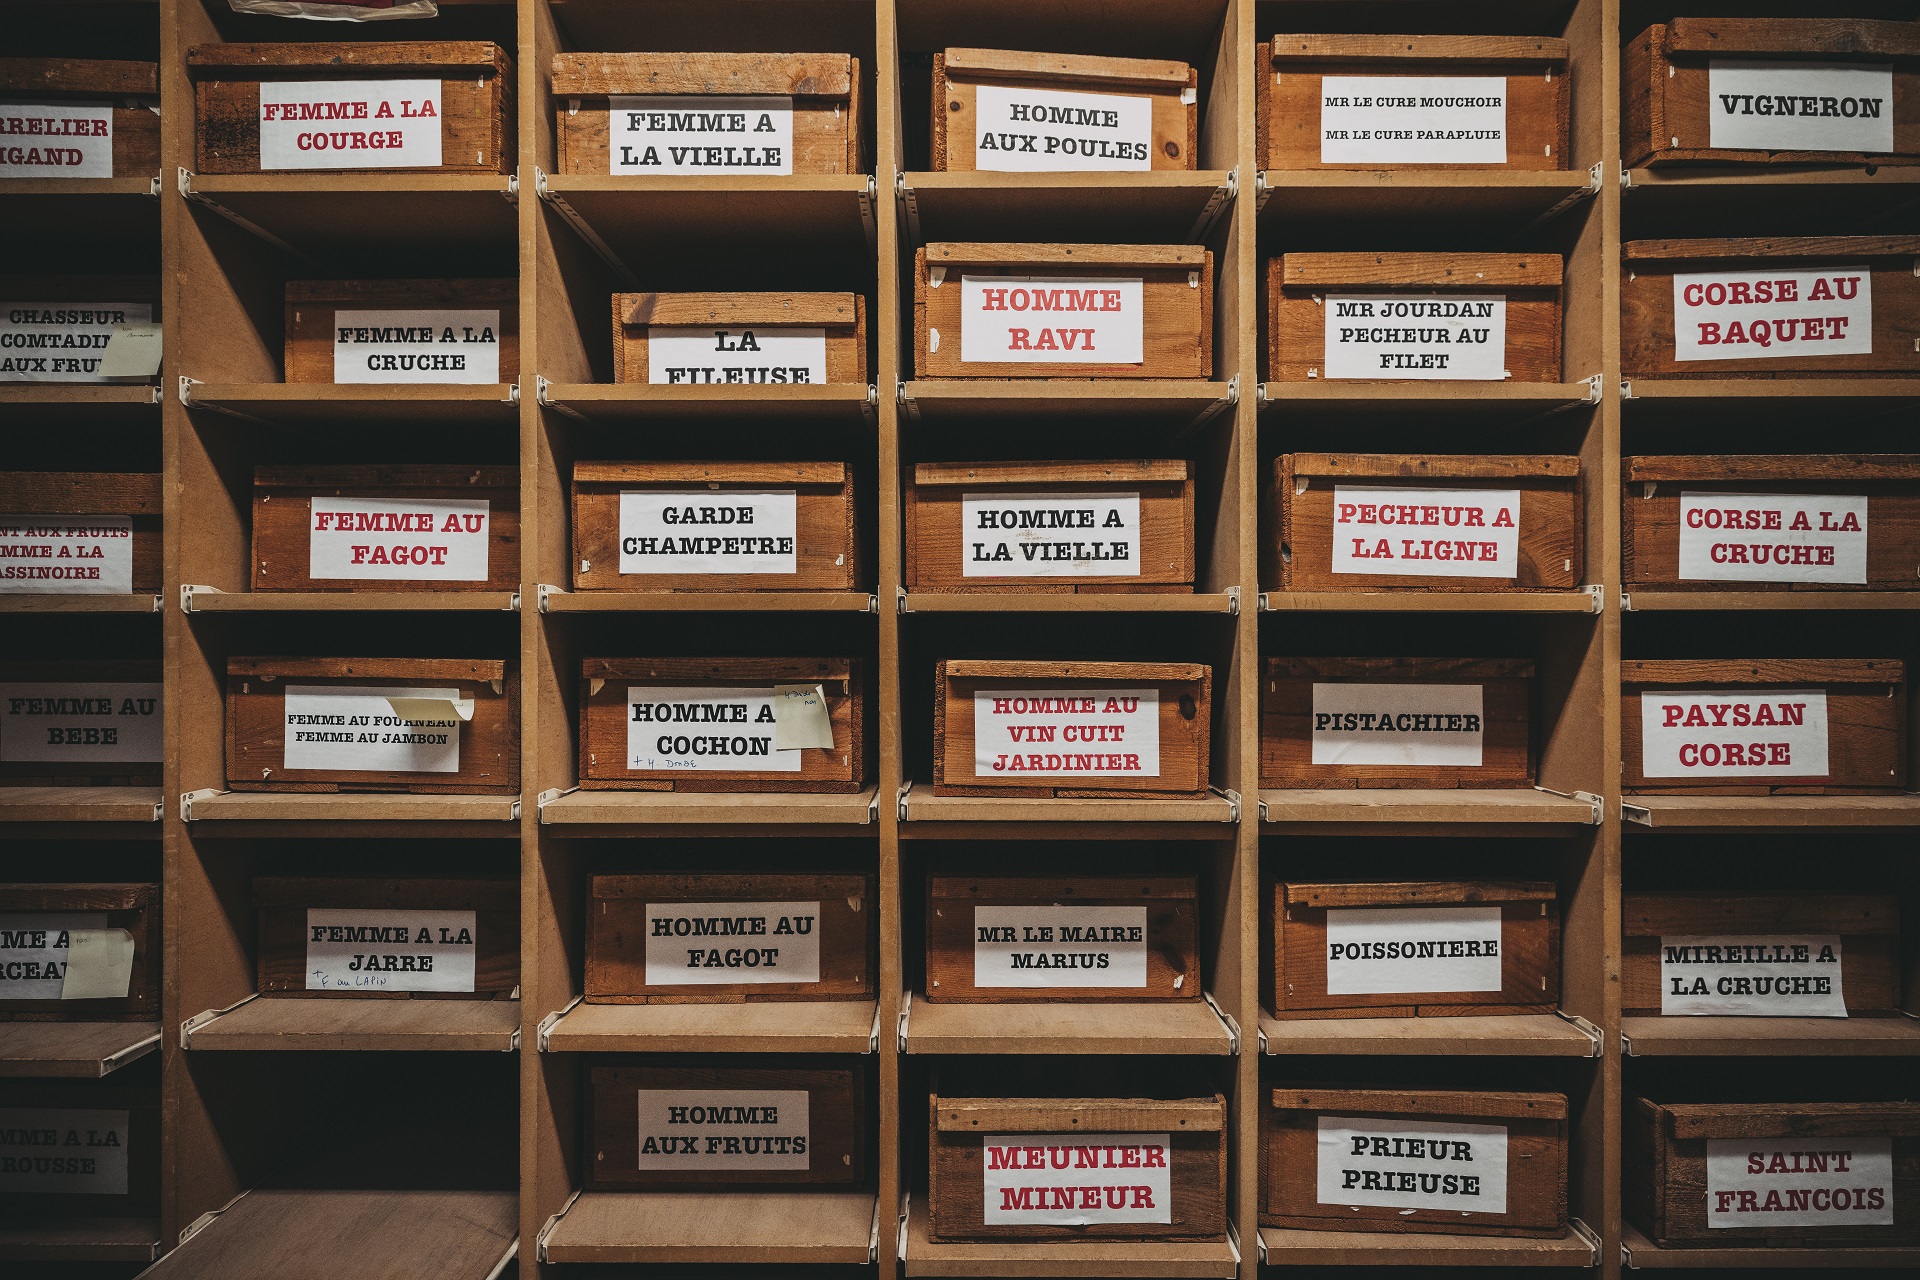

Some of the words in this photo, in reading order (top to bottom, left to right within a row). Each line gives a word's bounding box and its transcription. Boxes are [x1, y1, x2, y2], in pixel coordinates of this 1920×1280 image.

[263, 102, 368, 121] FEMME
[374, 101, 394, 118] A
[401, 100, 437, 118] LA
[1325, 97, 1350, 107] MR
[1353, 97, 1372, 107] LE
[1376, 97, 1416, 107] CURE
[1420, 97, 1501, 107] MOUCHOIR
[1719, 94, 1883, 118] VIGNERON
[627, 113, 745, 132] FEMME
[753, 114, 776, 132] A
[1010, 104, 1118, 128] HOMME
[297, 131, 403, 150] COURGE
[1326, 130, 1349, 139] MR
[1353, 130, 1370, 139] LE
[1374, 130, 1413, 140] CURE
[1416, 130, 1500, 139] PARAPLUIE
[979, 132, 1037, 152] AUX
[1044, 136, 1147, 160] POULES
[620, 146, 662, 165] LA
[668, 147, 781, 166] VIELLE
[982, 289, 1121, 312] HOMME
[1684, 280, 1798, 307] CORSE
[1807, 277, 1861, 301] AU
[9, 309, 126, 325] CHASSEUR
[1336, 303, 1375, 317] MR
[1380, 303, 1494, 317] JOURDAN
[338, 327, 433, 343] FEMME
[439, 327, 457, 343] A
[462, 327, 496, 343] LA
[1008, 328, 1095, 350] RAVI
[1340, 328, 1451, 343] PECHEUR
[1456, 328, 1490, 343] AU
[1698, 316, 1848, 347] BAQUET
[714, 331, 761, 352] LA
[0, 358, 47, 372] AUX
[51, 358, 102, 373] FRU
[368, 355, 465, 371] CRUCHE
[1380, 354, 1449, 369] FILET
[665, 366, 811, 384] FILEUSE
[315, 512, 433, 532] FEMME
[441, 514, 485, 533] AU
[662, 507, 753, 524] GARDE
[977, 510, 1095, 529] HOMME
[1102, 509, 1124, 528] A
[1338, 504, 1485, 527] PECHEUR
[1492, 508, 1515, 527] A
[1687, 508, 1781, 530] CORSE
[1789, 511, 1812, 531] A
[1819, 512, 1862, 532] LA
[24, 526, 62, 537] AUX
[65, 527, 129, 538] FRUITS
[57, 545, 72, 558] A
[76, 546, 104, 558] LA
[351, 545, 448, 565] FAGOT
[623, 537, 793, 555] CHAMPETRE
[972, 543, 1013, 561] LA
[1019, 542, 1129, 561] VIELLE
[1351, 538, 1394, 559] LA
[1401, 540, 1497, 561] LIGNE
[1711, 543, 1834, 566] CRUCHE
[8, 698, 112, 715] FEMME
[118, 698, 157, 716] AU
[632, 703, 747, 723] HOMME
[754, 704, 776, 723] A
[992, 696, 1096, 714] HOMME
[1101, 697, 1140, 713] AU
[288, 715, 345, 725] FEMME
[348, 716, 370, 726] AU
[1315, 713, 1480, 732] PISTACHIER
[1662, 703, 1806, 727] PAYSAN
[47, 727, 118, 745] BEBE
[296, 732, 354, 742] FEMME
[357, 733, 379, 743] AU
[382, 733, 448, 744] JAMBON
[1007, 726, 1057, 742] VIN
[1063, 725, 1125, 742] CUIT
[657, 736, 772, 756] COCHON
[1679, 743, 1791, 767] CORSE
[993, 754, 1141, 771] JARDINIER
[311, 926, 408, 943] FEMME
[414, 927, 433, 944] A
[439, 928, 473, 944] LA
[651, 917, 766, 936] HOMME
[773, 916, 815, 935] AU
[977, 927, 1018, 942] MR
[1023, 927, 1053, 942] LE
[1059, 927, 1142, 942] MAIRE
[687, 948, 779, 968] FAGOT
[1330, 940, 1498, 960] POISSONIERE
[1663, 945, 1809, 964] MIREILLE
[1816, 945, 1837, 963] A
[0, 961, 67, 980] CEA
[349, 954, 433, 972] JARRE
[1011, 953, 1109, 969] MARIUS
[1671, 977, 1710, 995] LA
[1717, 977, 1831, 995] CRUCHE
[668, 1106, 778, 1124] HOMME
[62, 1130, 82, 1146] A
[86, 1130, 121, 1147] LA
[641, 1136, 699, 1154] AUX
[705, 1136, 806, 1154] FRUITS
[988, 1144, 1166, 1170] MEUNIER
[1351, 1136, 1473, 1161] PRIEUR
[1, 1157, 96, 1175] ROUSSE
[1747, 1150, 1853, 1175] SAINT
[1342, 1169, 1480, 1196] PRIEUSE
[1000, 1186, 1155, 1210] MINEUR
[1715, 1188, 1885, 1213] FRANCOIS
